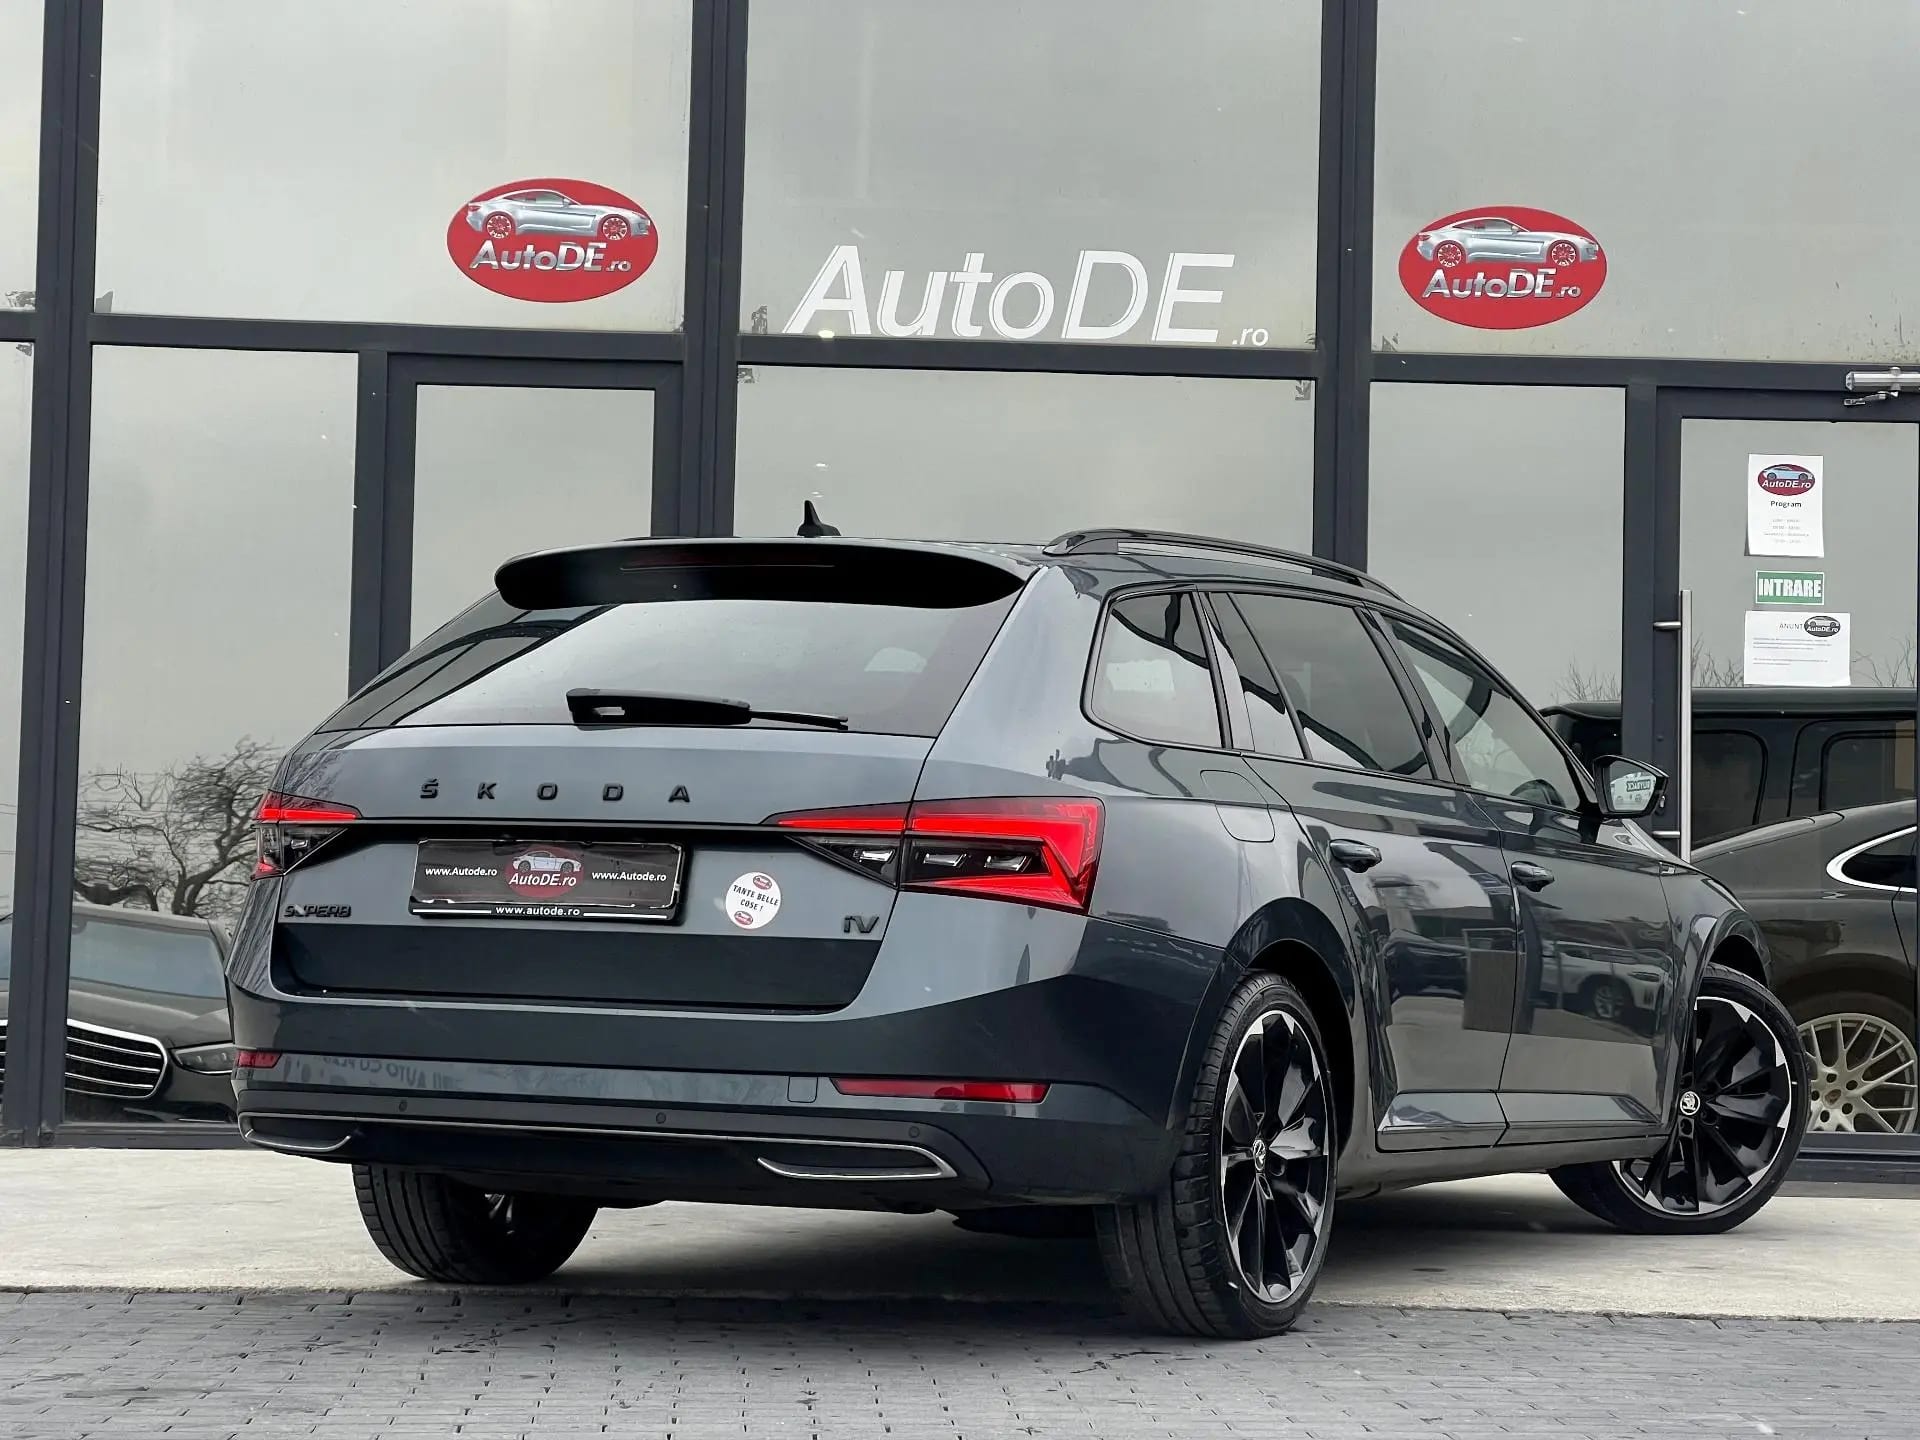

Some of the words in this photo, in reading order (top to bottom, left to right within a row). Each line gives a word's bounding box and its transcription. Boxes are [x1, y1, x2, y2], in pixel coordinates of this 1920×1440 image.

[1770, 500, 1802, 508] Program
[1758, 578, 1822, 598] INTRARE
[420, 778, 691, 803] ŠKODA
[425, 866, 498, 876] www.Autode.ro
[591, 871, 667, 882] www.Autode.ro
[509, 873, 577, 886] AutoDE.ro
[733, 884, 756, 898] TANTE
[756, 892, 779, 906] BELLE
[740, 898, 758, 911] COSE
[495, 906, 581, 917] www.autode.ro
